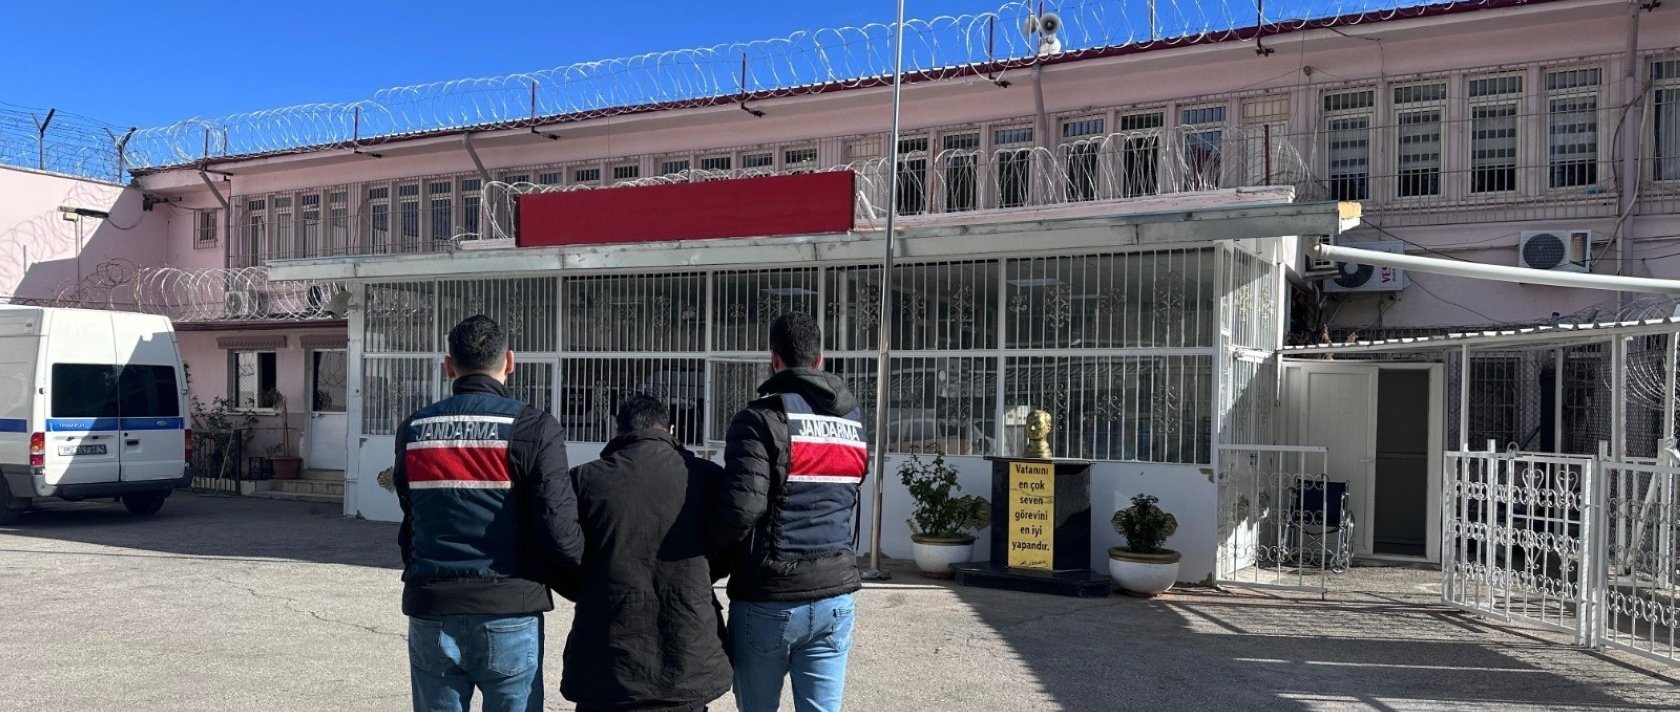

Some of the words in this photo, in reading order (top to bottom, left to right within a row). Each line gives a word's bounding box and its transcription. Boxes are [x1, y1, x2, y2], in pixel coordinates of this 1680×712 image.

[415, 420, 499, 441] JANDARMA
[799, 419, 861, 441] JANDARMA
[1015, 463, 1049, 476] Vatanını
[1018, 481, 1029, 490] en
[1030, 480, 1046, 492] çok
[1019, 495, 1044, 505] seven
[1014, 509, 1048, 522] görevini
[1020, 525, 1030, 535] en
[1031, 524, 1043, 538] iyi
[1011, 540, 1050, 552] yapandır.
